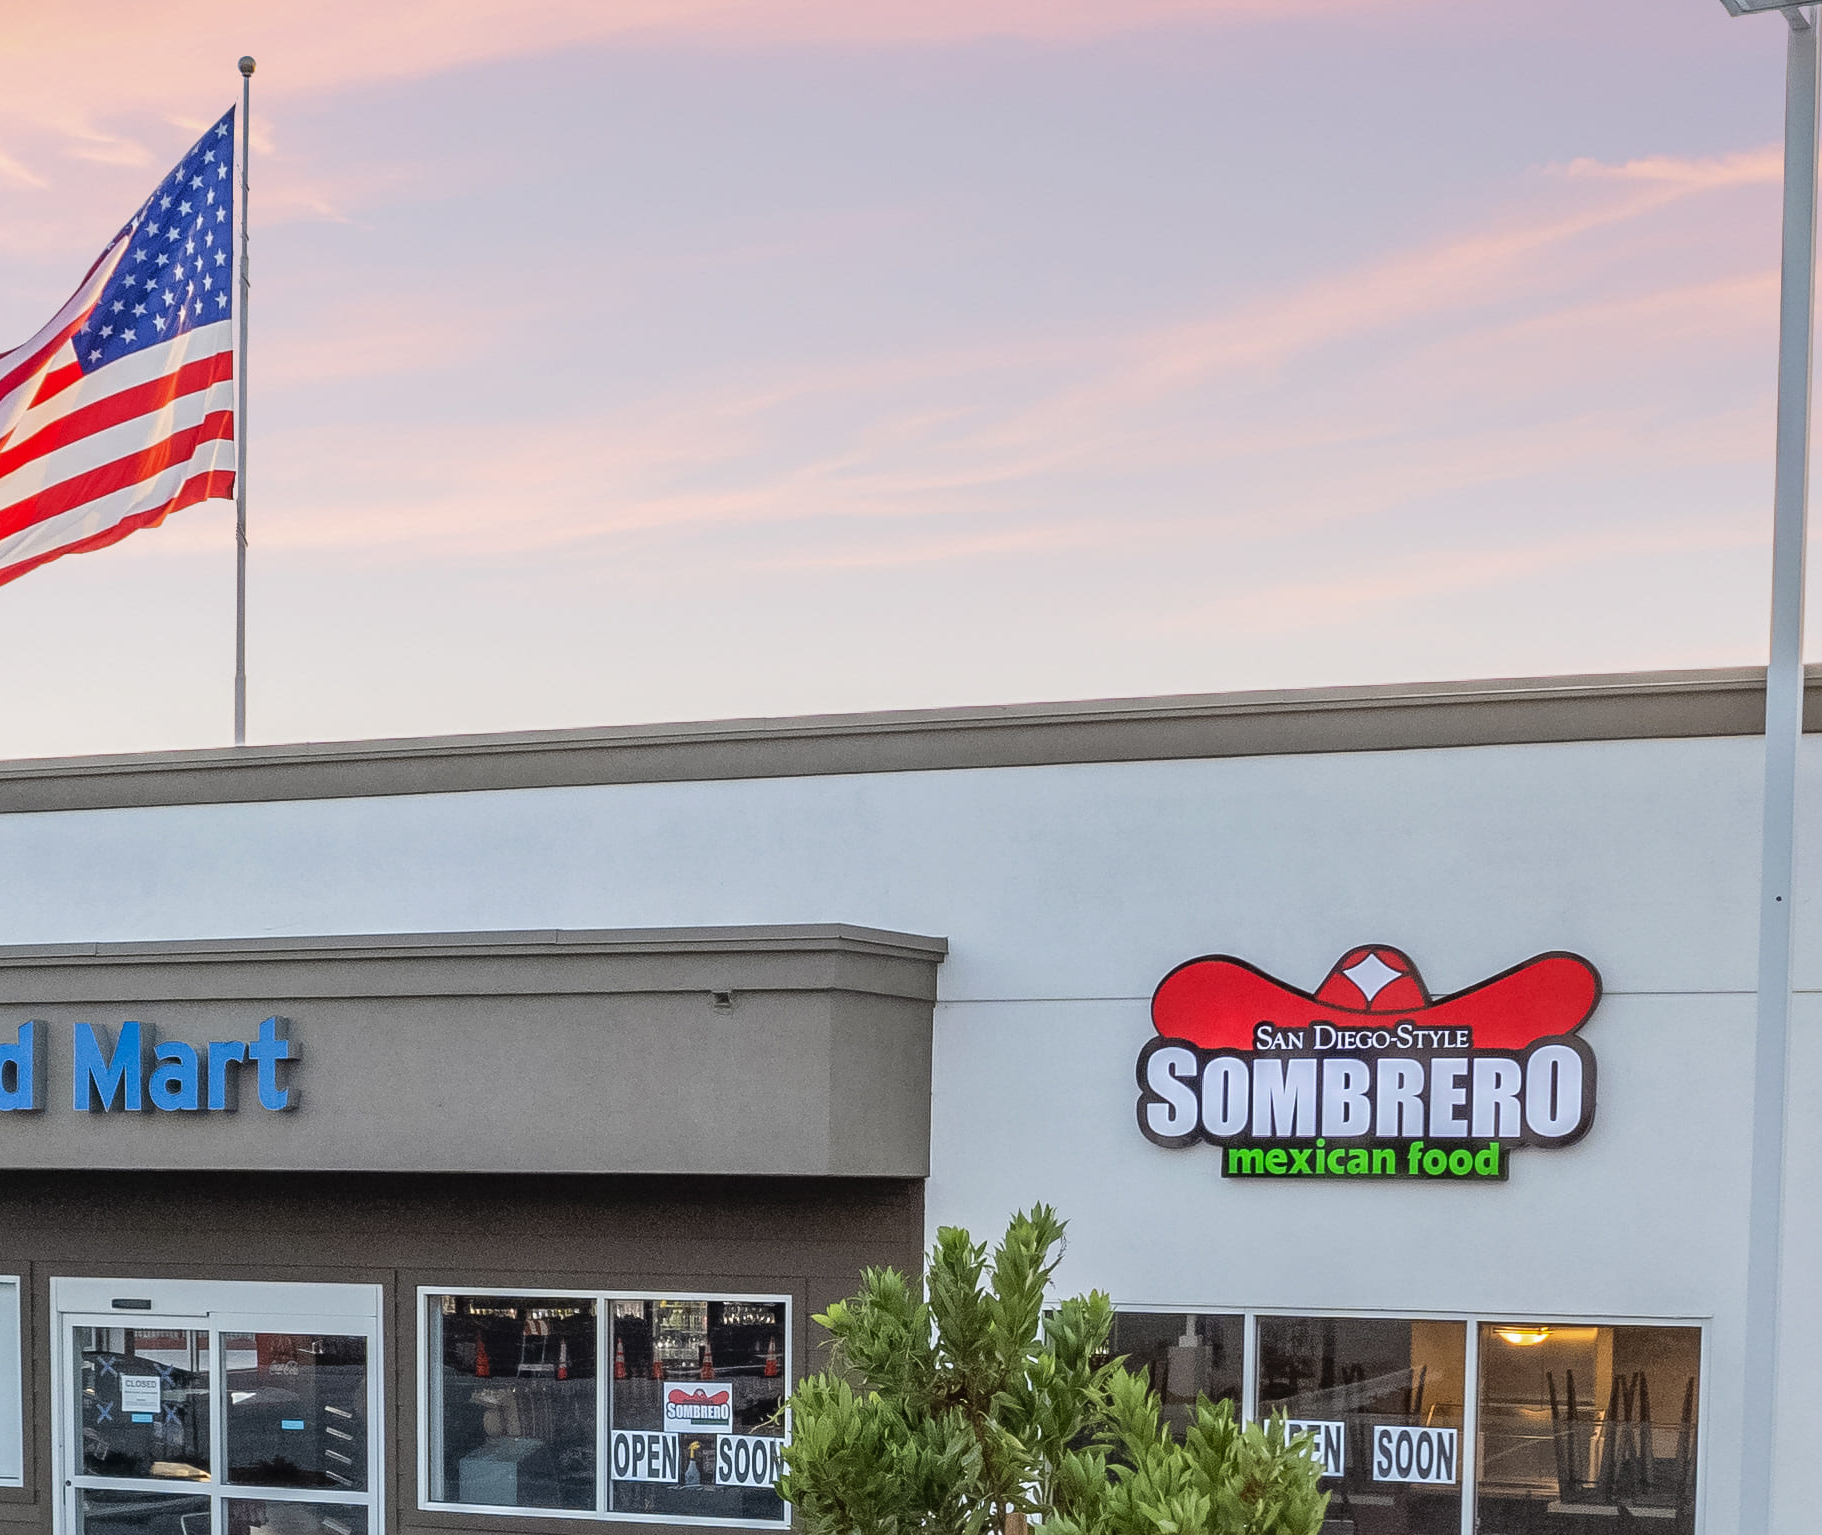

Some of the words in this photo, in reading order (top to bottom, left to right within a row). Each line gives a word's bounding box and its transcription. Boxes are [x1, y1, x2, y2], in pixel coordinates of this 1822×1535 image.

[71, 1015, 289, 1113] Mart
[1145, 1045, 1584, 1138] SOMBRERO
[1227, 1138, 1397, 1175] mexican
[1408, 1141, 1501, 1176] food
[125, 1380, 157, 1388] CLOSED
[667, 1403, 729, 1419] SOMBRERO
[613, 1433, 677, 1480] OPEN
[718, 1437, 786, 1485] SOON
[1376, 1429, 1454, 1480] SOON
